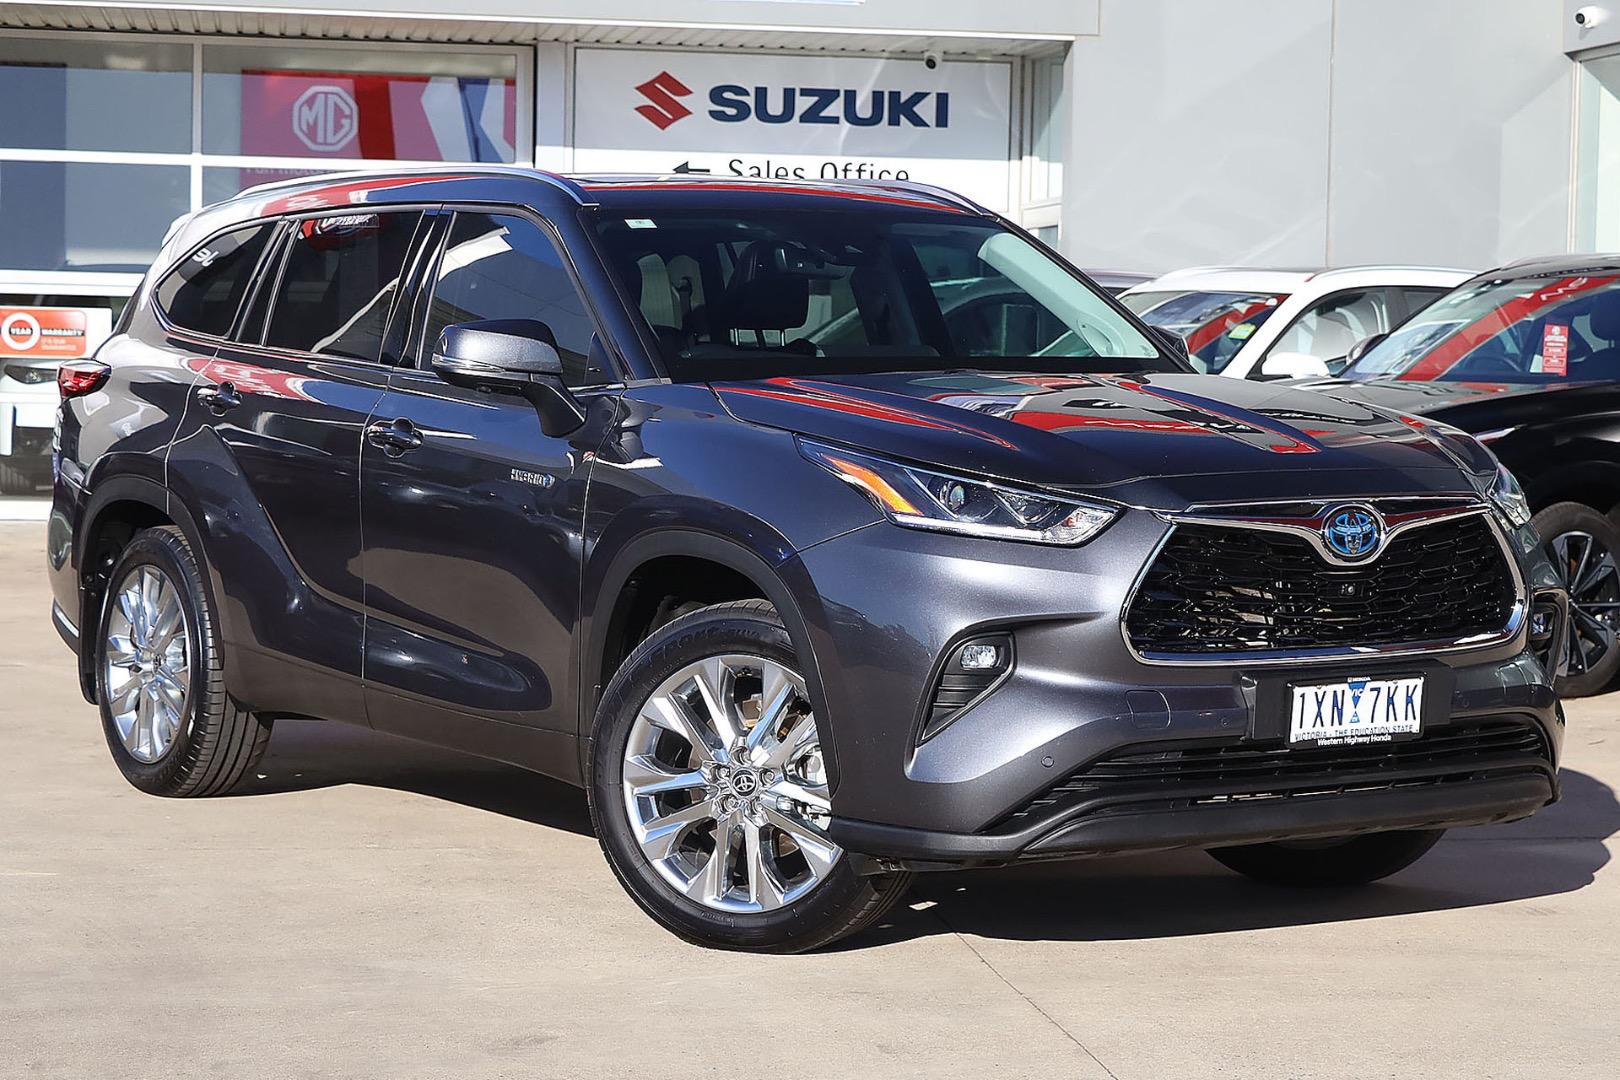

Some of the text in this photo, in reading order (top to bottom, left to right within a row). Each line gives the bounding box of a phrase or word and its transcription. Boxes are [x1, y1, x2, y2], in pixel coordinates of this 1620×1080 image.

[298, 91, 354, 146] MG
[707, 84, 950, 129] SUZUKI
[728, 158, 910, 181] Sales Office
[1299, 684, 1418, 729] 1XN 7KK
[1317, 734, 1392, 746] Western Highway Honda
